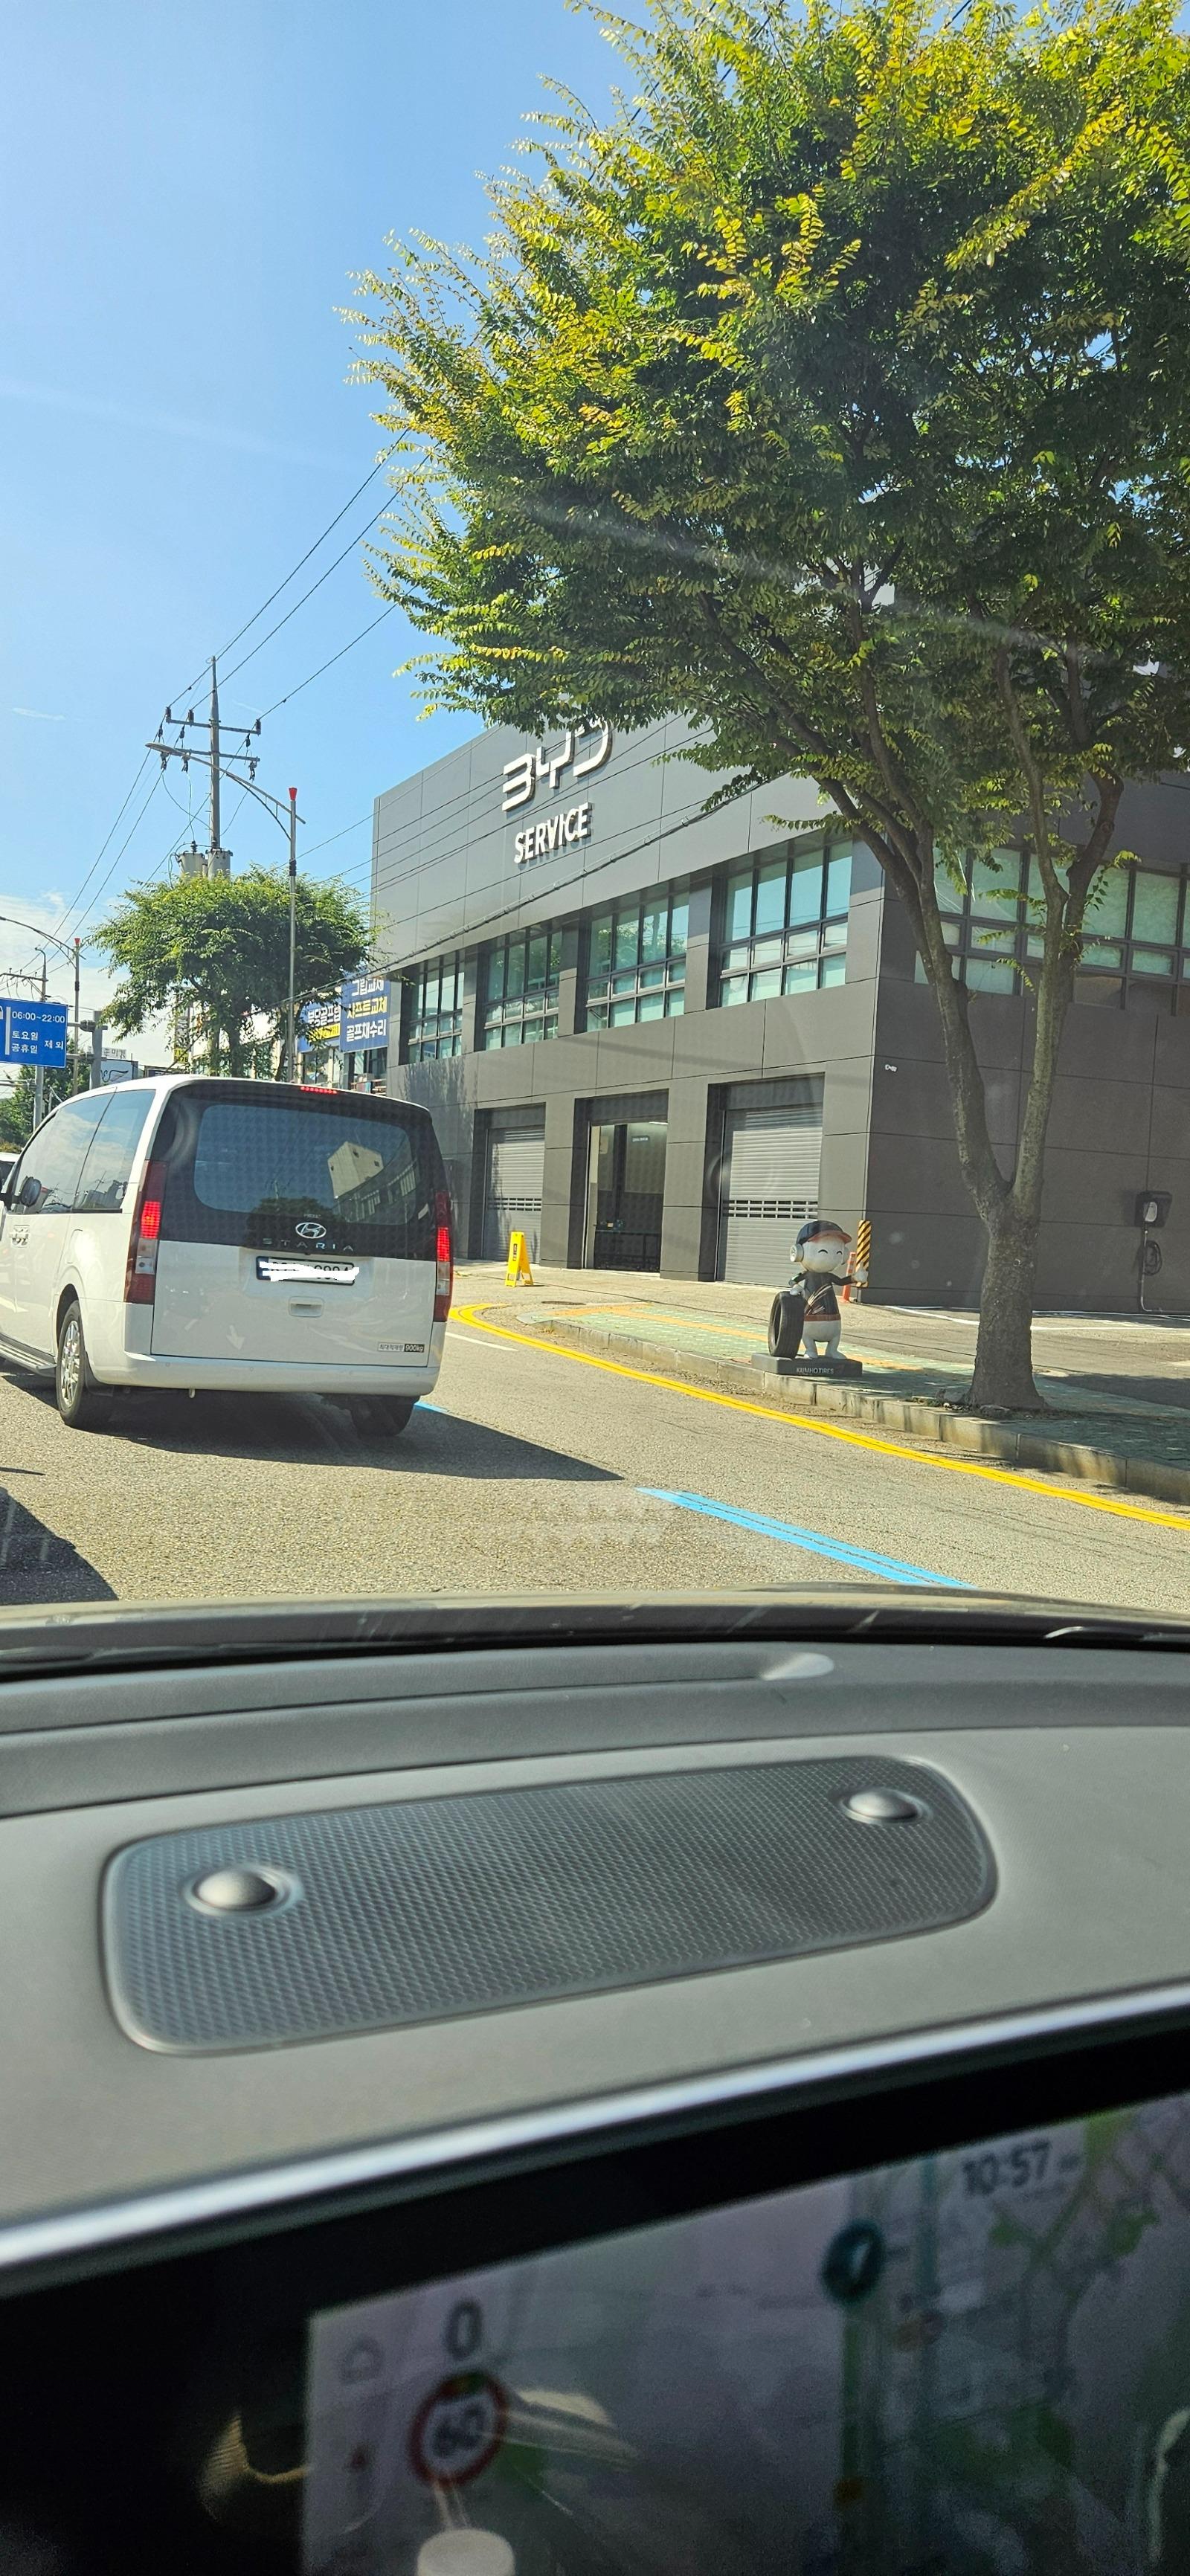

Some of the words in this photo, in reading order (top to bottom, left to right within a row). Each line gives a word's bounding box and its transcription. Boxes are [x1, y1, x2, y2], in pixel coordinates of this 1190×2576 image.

[502, 719, 609, 811] BYD
[514, 802, 589, 863] SERVICE
[12, 1011, 65, 1023] 06:00~22:00
[12, 1031, 38, 1041] 토요일
[346, 1019, 387, 1042] 골프채수리
[12, 1043, 38, 1054] 공휴일
[45, 1040, 64, 1050] 제외
[263, 1238, 353, 1251] STARIA
[405, 1345, 424, 1353] 900kg
[962, 2139, 1052, 2196] 10:57
